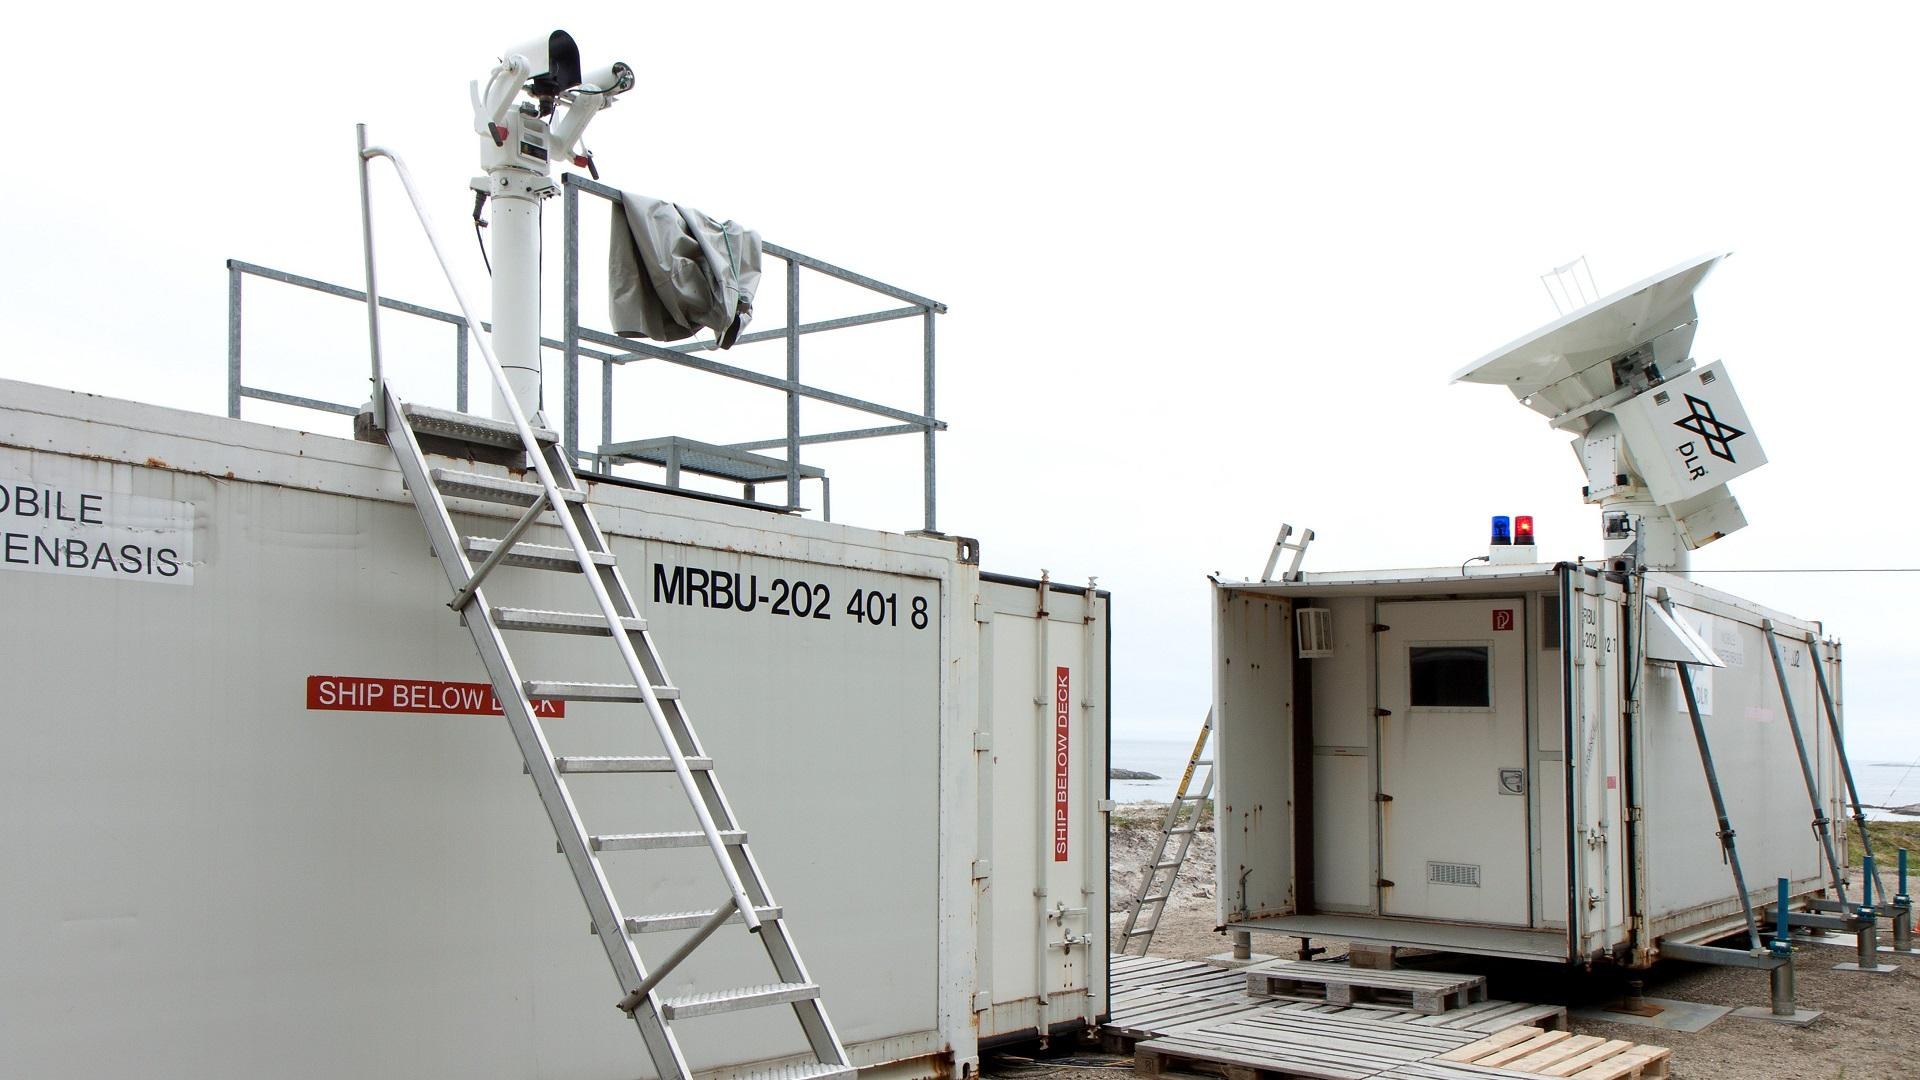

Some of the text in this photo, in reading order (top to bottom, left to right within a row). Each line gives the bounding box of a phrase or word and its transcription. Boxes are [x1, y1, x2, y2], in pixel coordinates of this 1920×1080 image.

[1679, 441, 1706, 481] DLR
[0, 531, 179, 577] ENBASIS
[653, 563, 928, 630] MRBU-202 401 8
[319, 681, 384, 707] SHIP
[393, 684, 484, 710] BELOW
[1056, 674, 1068, 854] SHIP BELOW DECK
